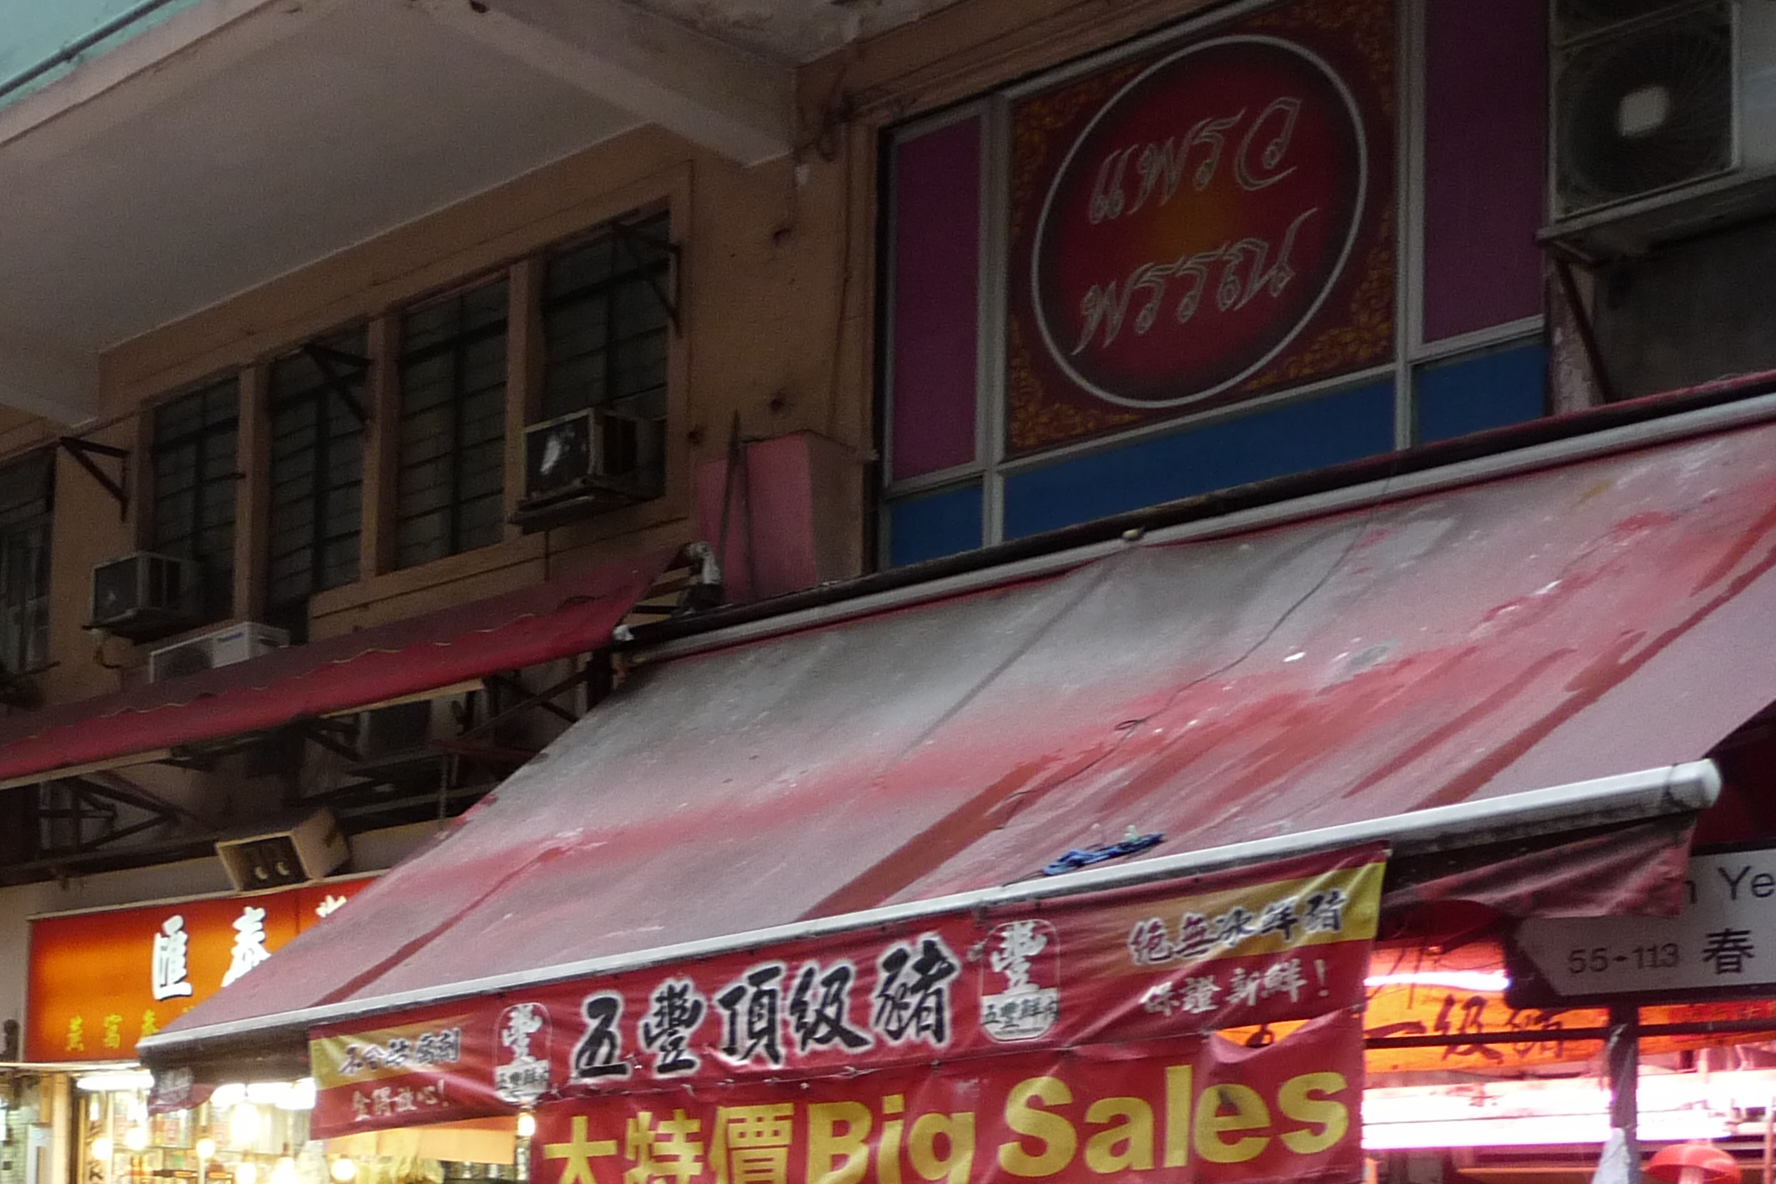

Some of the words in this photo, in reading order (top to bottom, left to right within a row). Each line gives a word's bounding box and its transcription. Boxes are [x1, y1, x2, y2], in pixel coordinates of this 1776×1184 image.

[1089, 97, 1304, 225] แพรว
[1070, 207, 1319, 356] พรรณ
[1702, 927, 1756, 976] 春
[997, 1064, 1350, 1178] Sales
